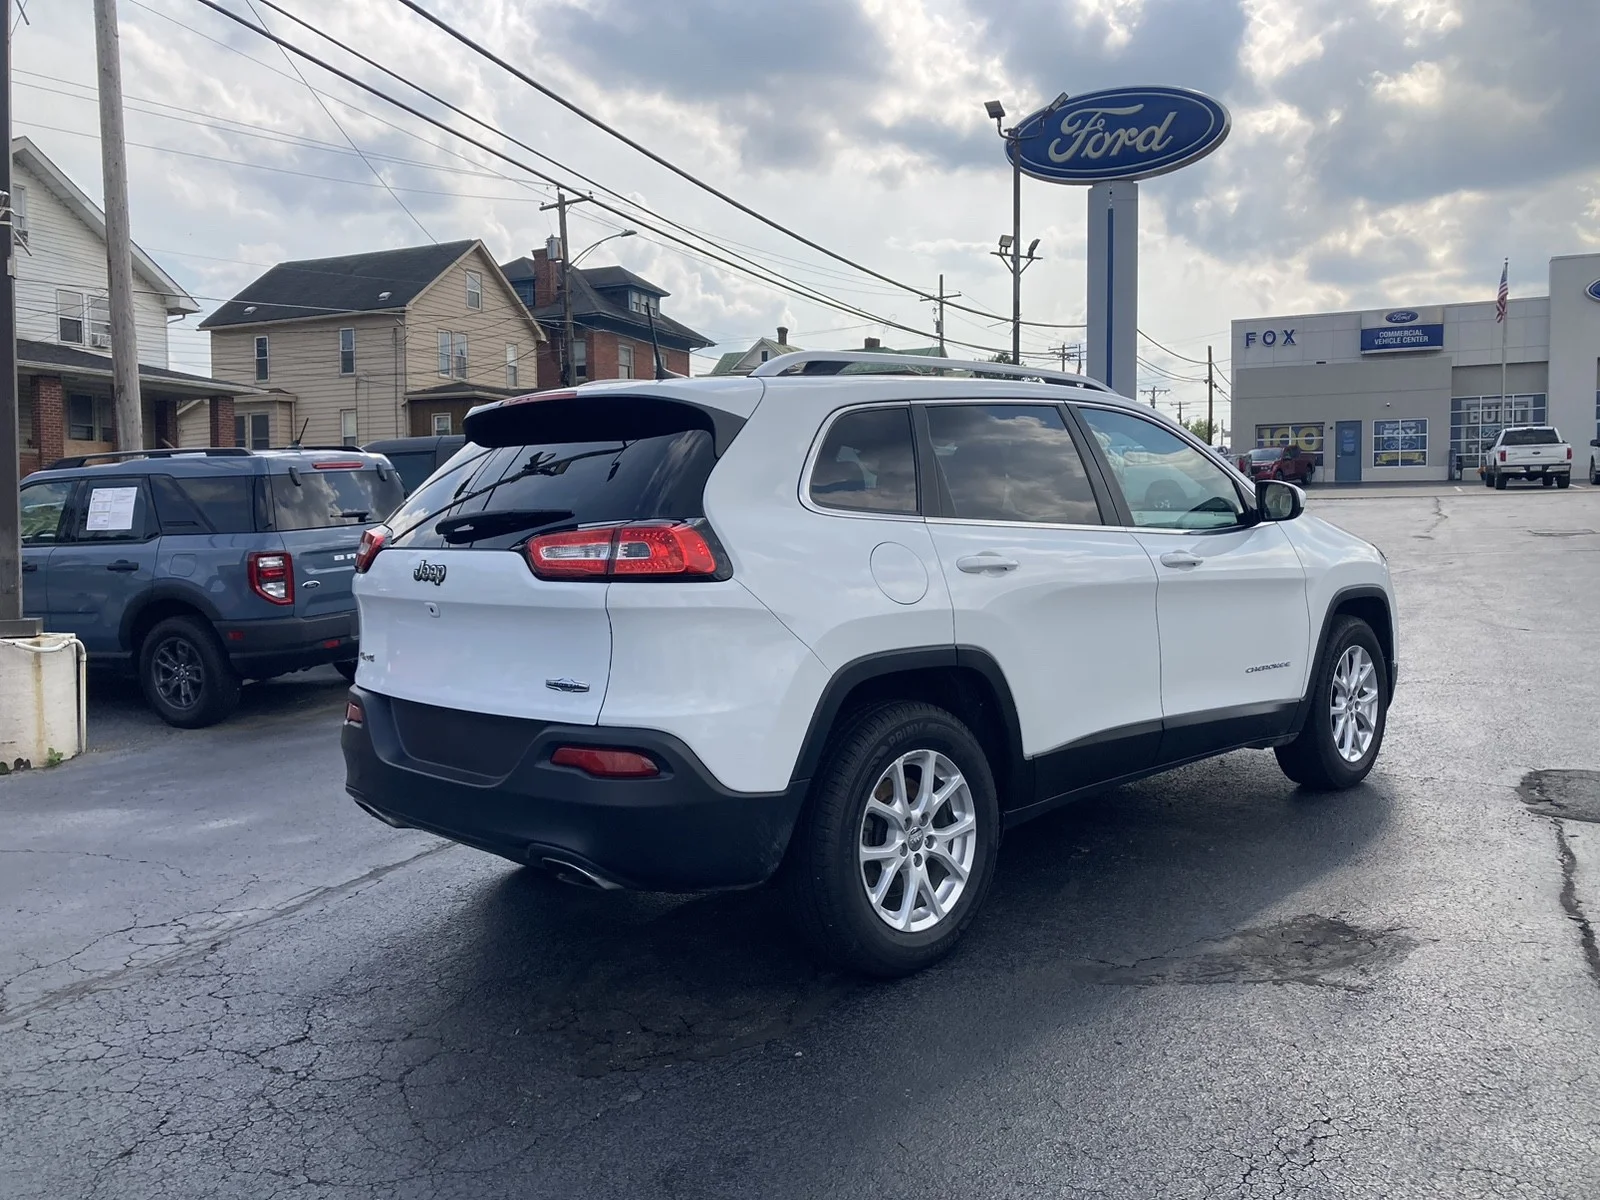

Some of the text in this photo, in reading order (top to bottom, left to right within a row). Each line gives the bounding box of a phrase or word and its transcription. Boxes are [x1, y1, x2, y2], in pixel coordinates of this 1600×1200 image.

[1048, 103, 1178, 163] Ford
[1392, 312, 1412, 321] Ford
[1245, 329, 1296, 348] FOX
[1374, 335, 1429, 345] VEHICLE CENTER
[1379, 329, 1424, 338] COMMERCIAL
[1469, 404, 1526, 423] BUILT
[1260, 427, 1322, 451] 100
[1384, 428, 1416, 440] FOX
[413, 560, 446, 586] Jeep
[1245, 661, 1291, 673] CHEROKEE
